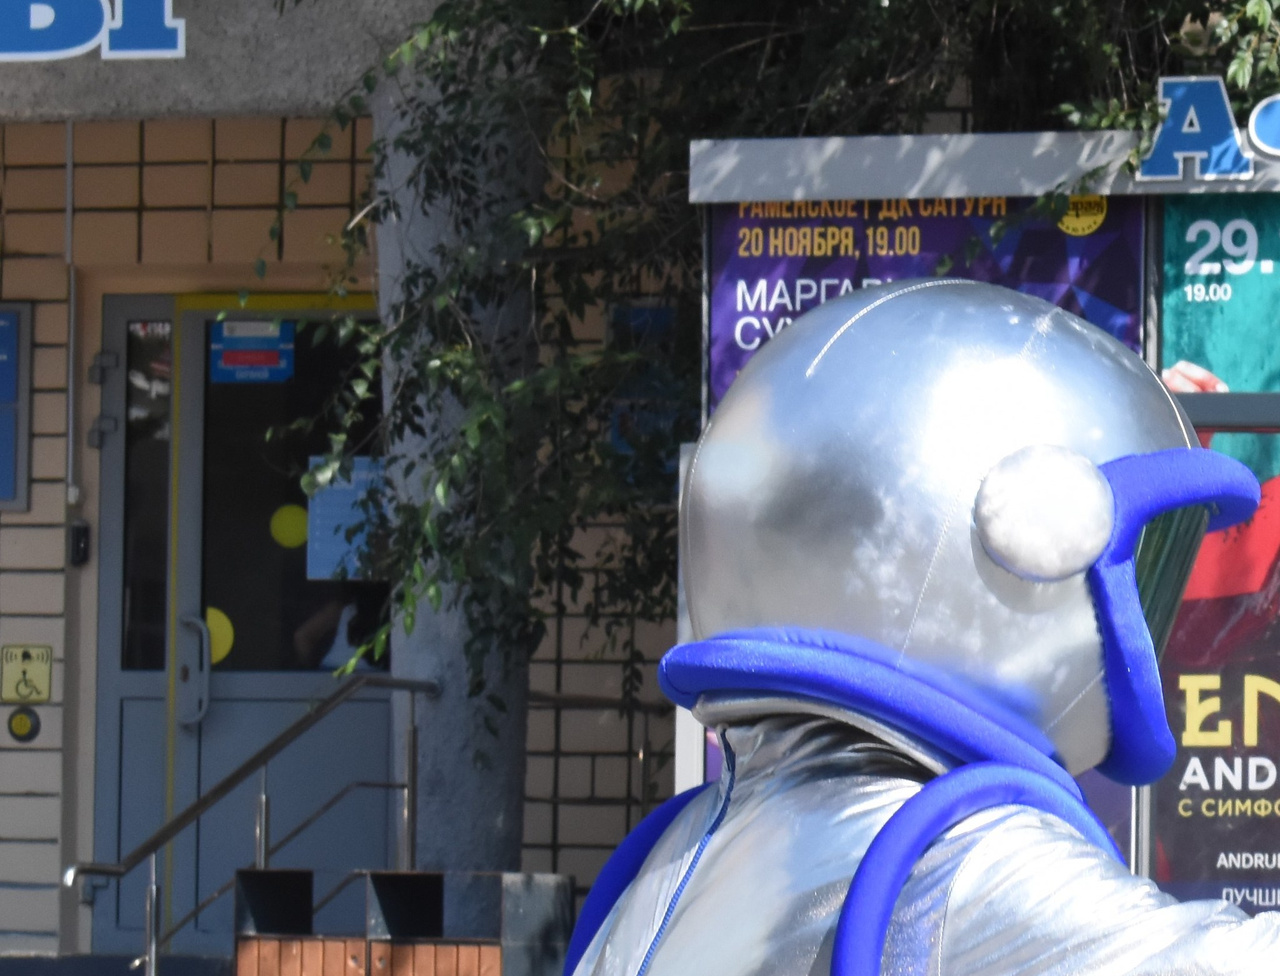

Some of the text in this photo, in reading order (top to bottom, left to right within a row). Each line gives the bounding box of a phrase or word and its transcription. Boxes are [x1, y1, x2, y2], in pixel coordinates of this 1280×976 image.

[878, 197, 913, 221] ДК
[918, 196, 1007, 217] САТУРН
[738, 226, 920, 260] 20 НОЯБРЯ, 19.00
[736, 278, 892, 312] МАРГ
[1184, 283, 1232, 302] 19.00
[734, 316, 793, 351] СУ
[1178, 798, 1193, 817] С
